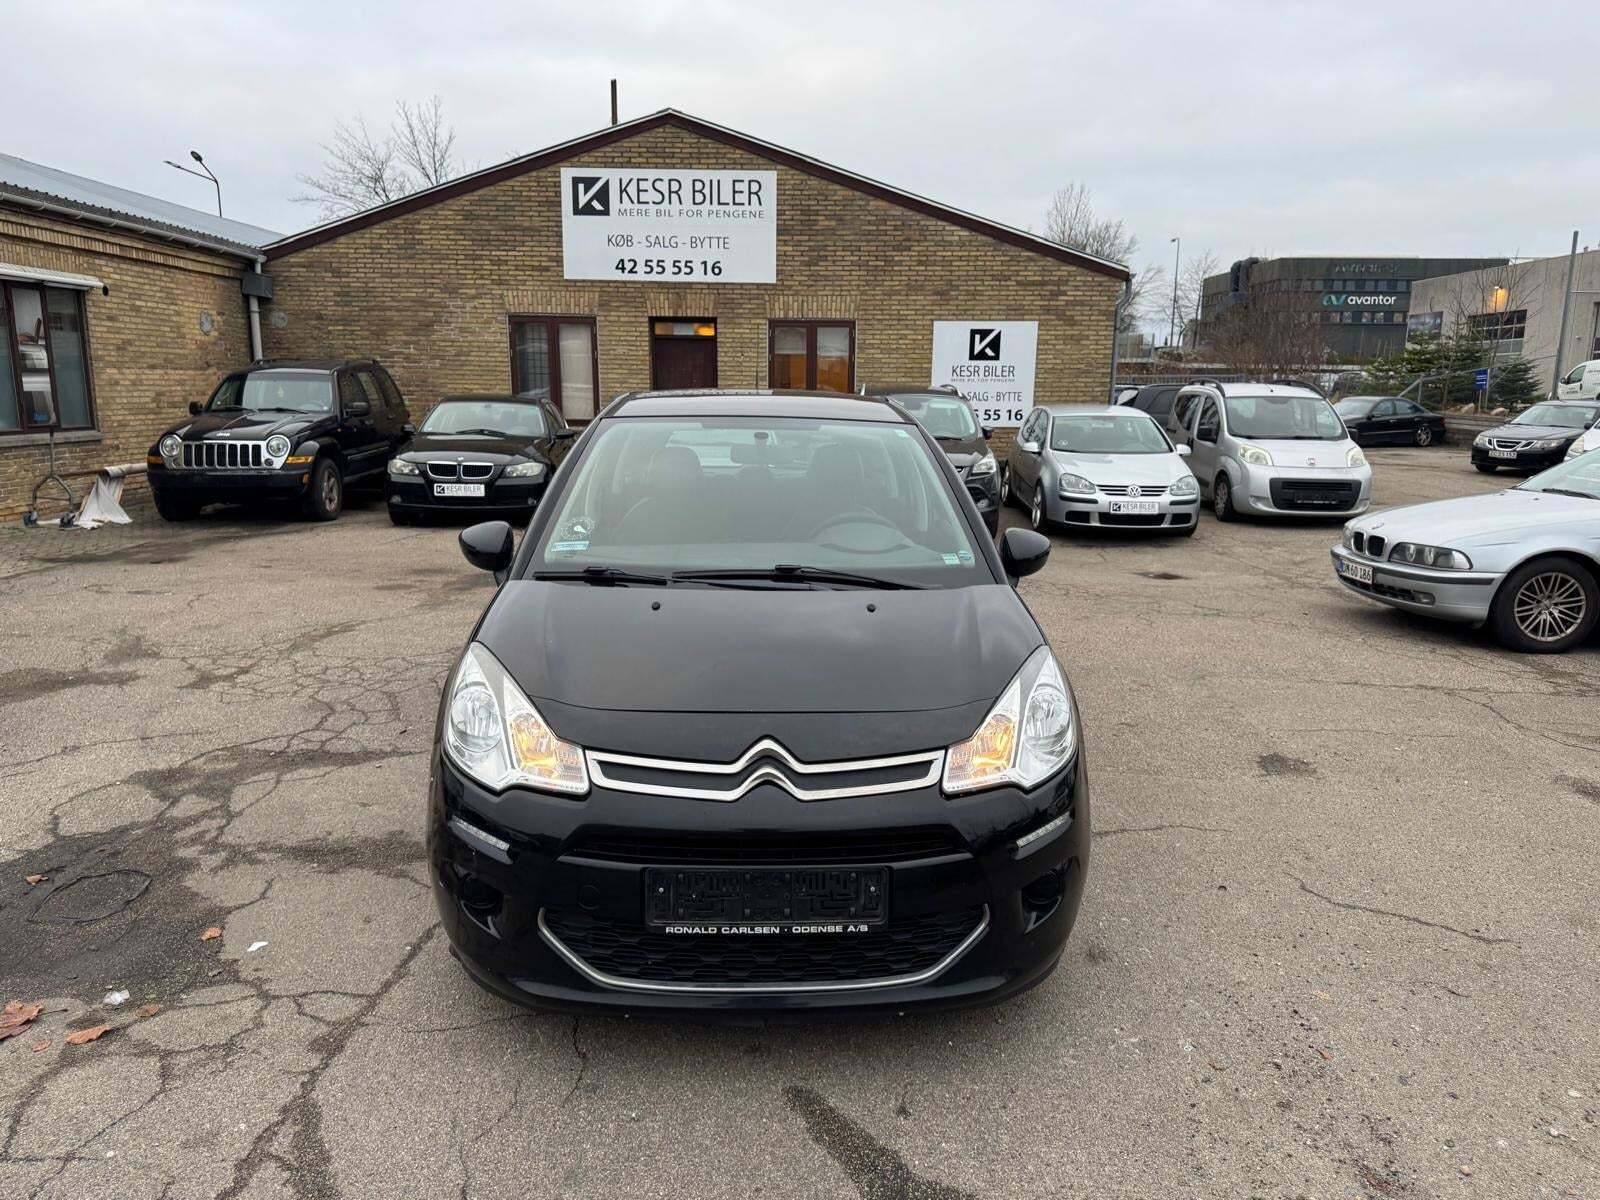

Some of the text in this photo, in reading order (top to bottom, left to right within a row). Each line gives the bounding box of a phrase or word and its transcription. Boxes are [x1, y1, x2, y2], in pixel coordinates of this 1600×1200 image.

[618, 177, 763, 206] KESR BILER
[617, 208, 765, 219] MERE BIL FOR PENGENE
[607, 234, 634, 248] KØB
[645, 235, 678, 249] SALG
[690, 236, 730, 250] BYTTE
[615, 258, 722, 276] 42 55 55 16
[1347, 294, 1397, 305] avantor
[951, 365, 1015, 378] KESR BILER
[967, 391, 989, 401] SALG
[995, 391, 1022, 402] BYTTE
[983, 408, 1001, 421] 55
[1006, 408, 1023, 421] 16
[665, 926, 718, 934] RONALD
[721, 926, 780, 934] CARLSEN
[847, 924, 868, 932] A/S
